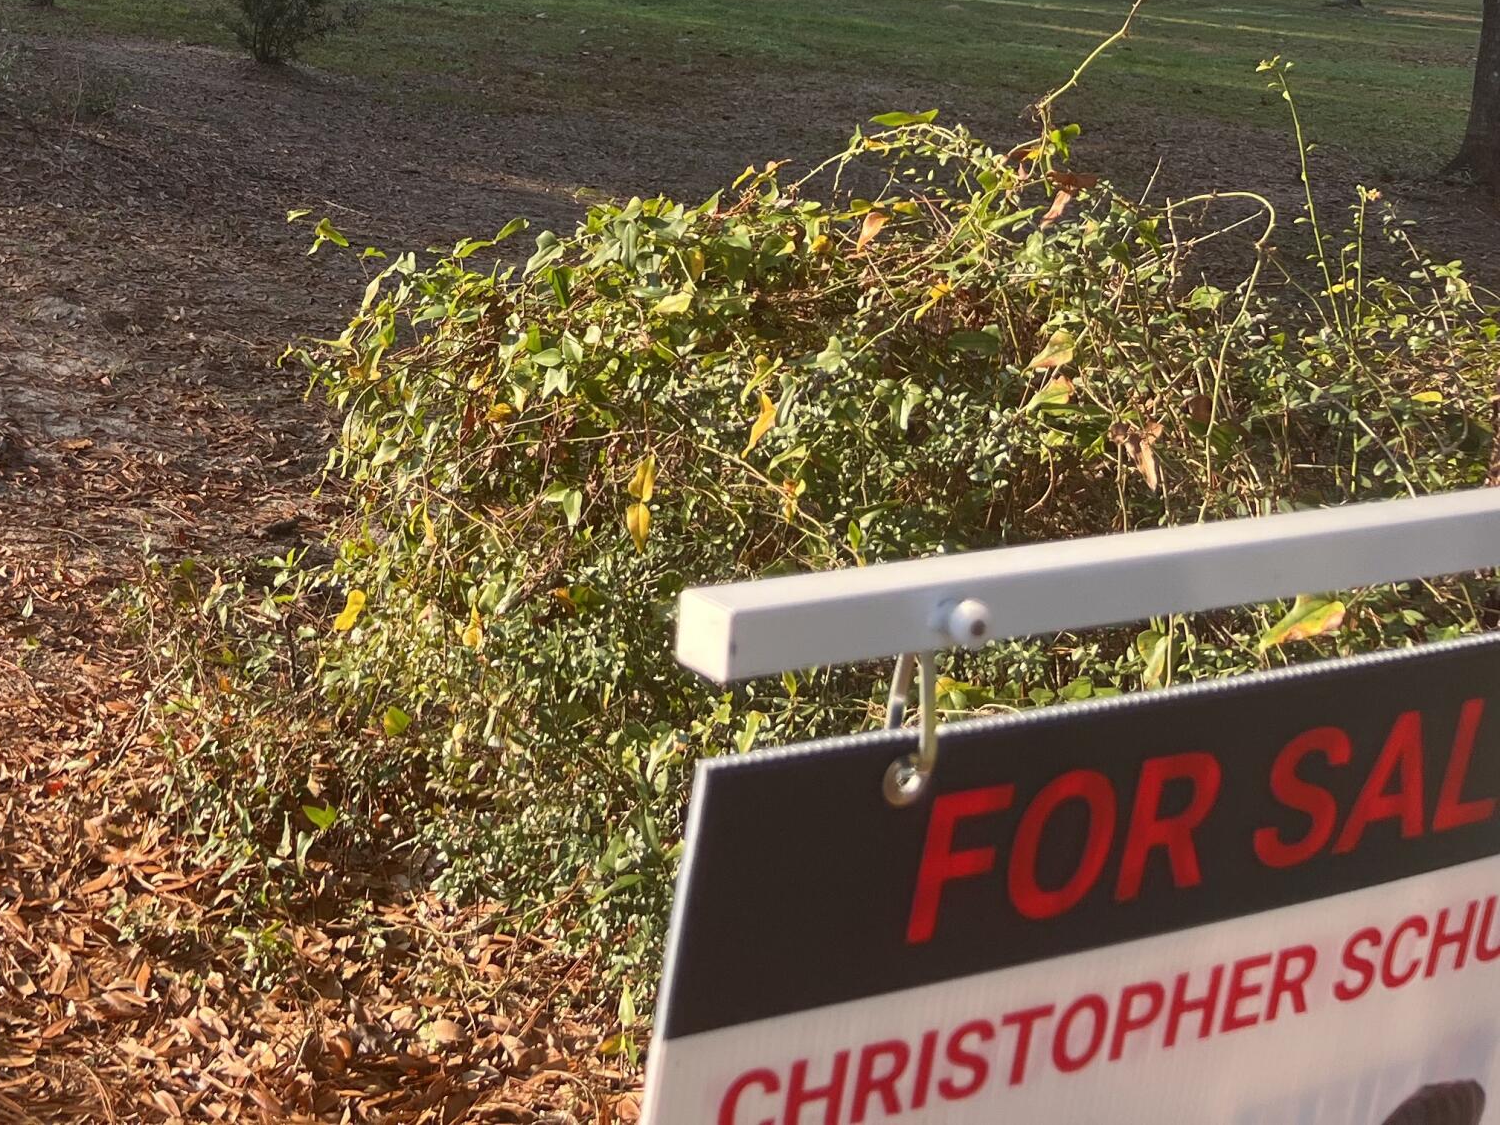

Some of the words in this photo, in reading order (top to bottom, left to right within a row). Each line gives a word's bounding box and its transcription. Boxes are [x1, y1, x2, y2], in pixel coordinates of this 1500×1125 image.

[906, 751, 1222, 944] FOR
[1252, 697, 1498, 869] SAL
[716, 942, 1318, 1125] CHRISTOPHER
